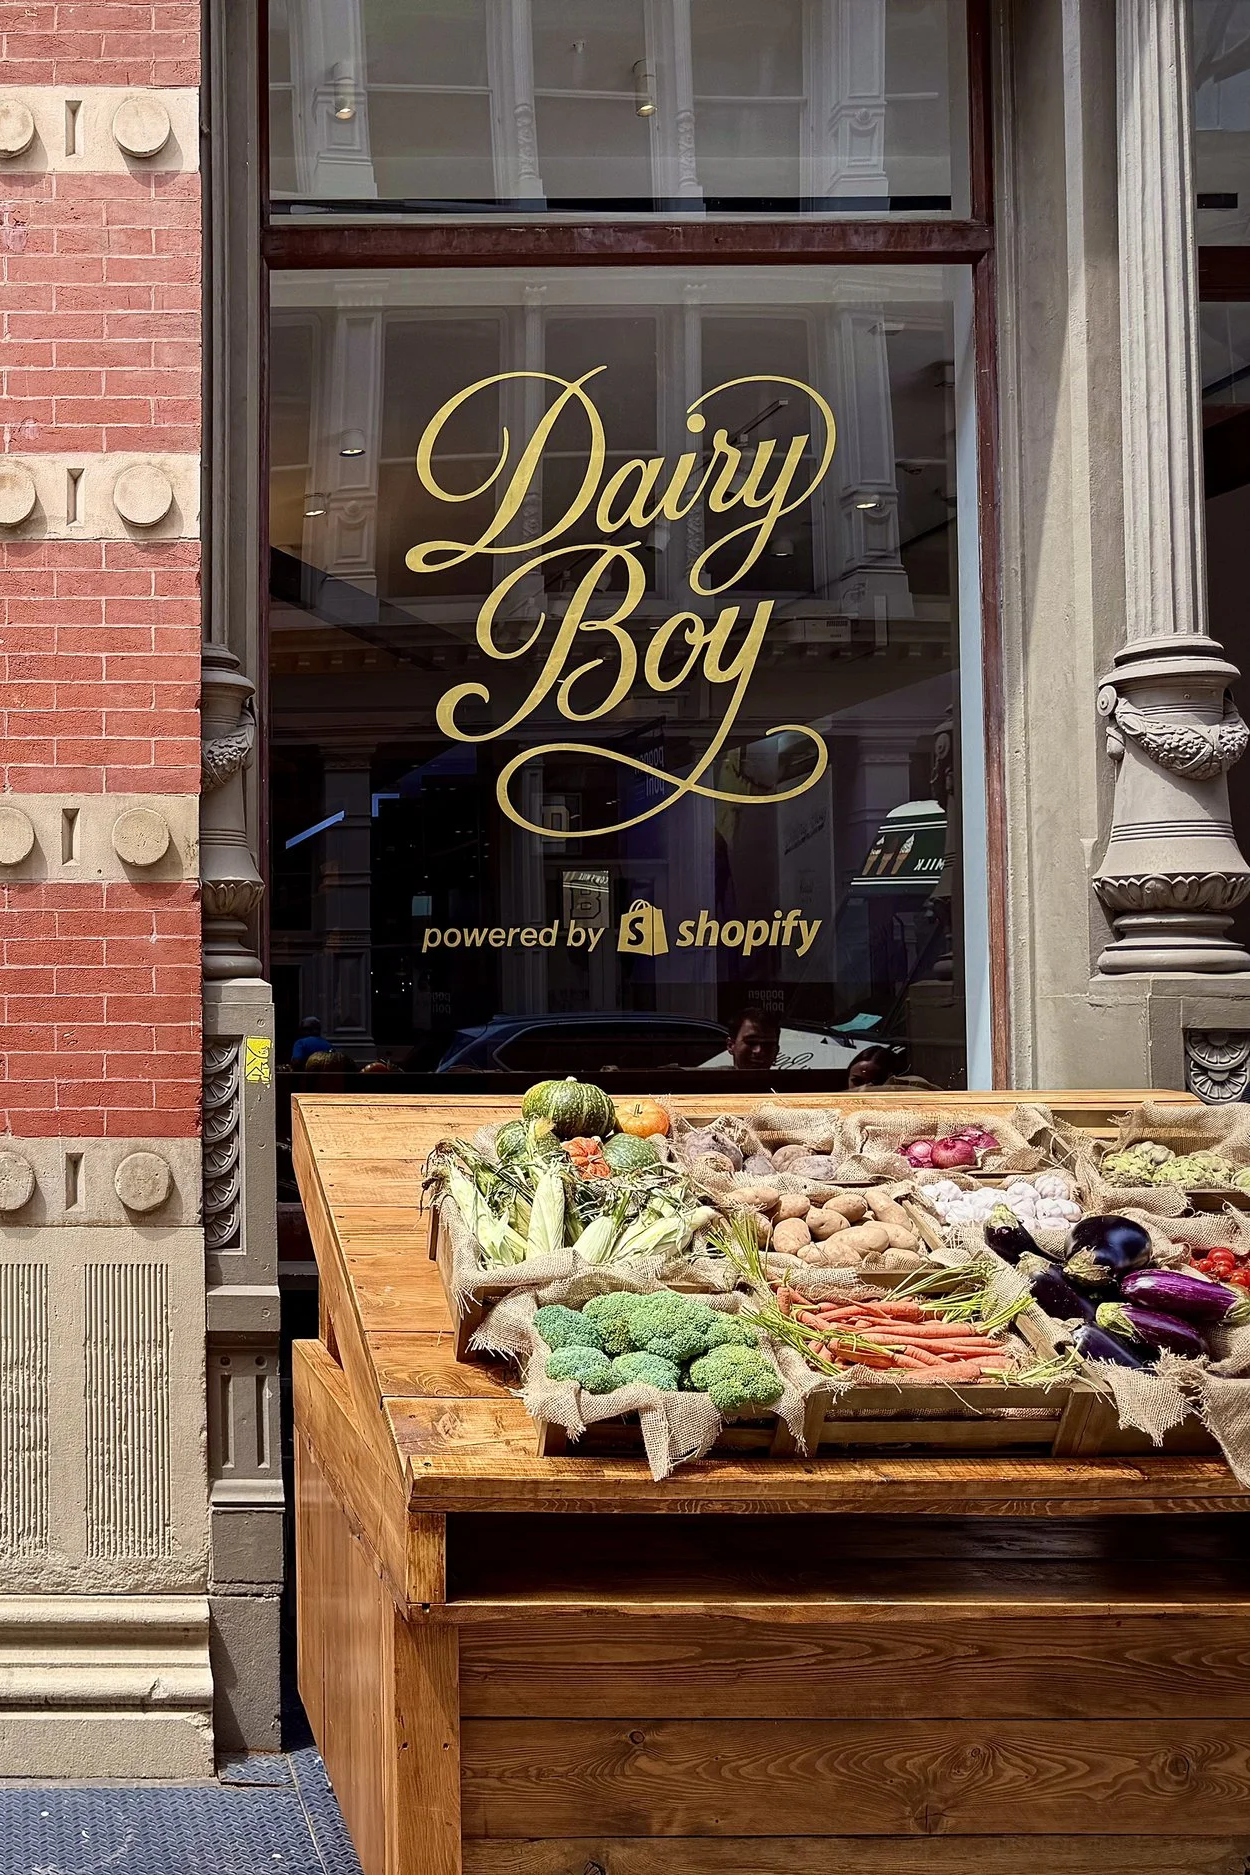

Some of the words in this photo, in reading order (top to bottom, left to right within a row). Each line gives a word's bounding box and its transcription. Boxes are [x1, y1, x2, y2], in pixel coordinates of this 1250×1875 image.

[405, 366, 837, 596] Dairy
[436, 543, 828, 838] Boy
[422, 920, 557, 953] powered
[566, 920, 606, 952] by
[676, 909, 822, 957] shopify
